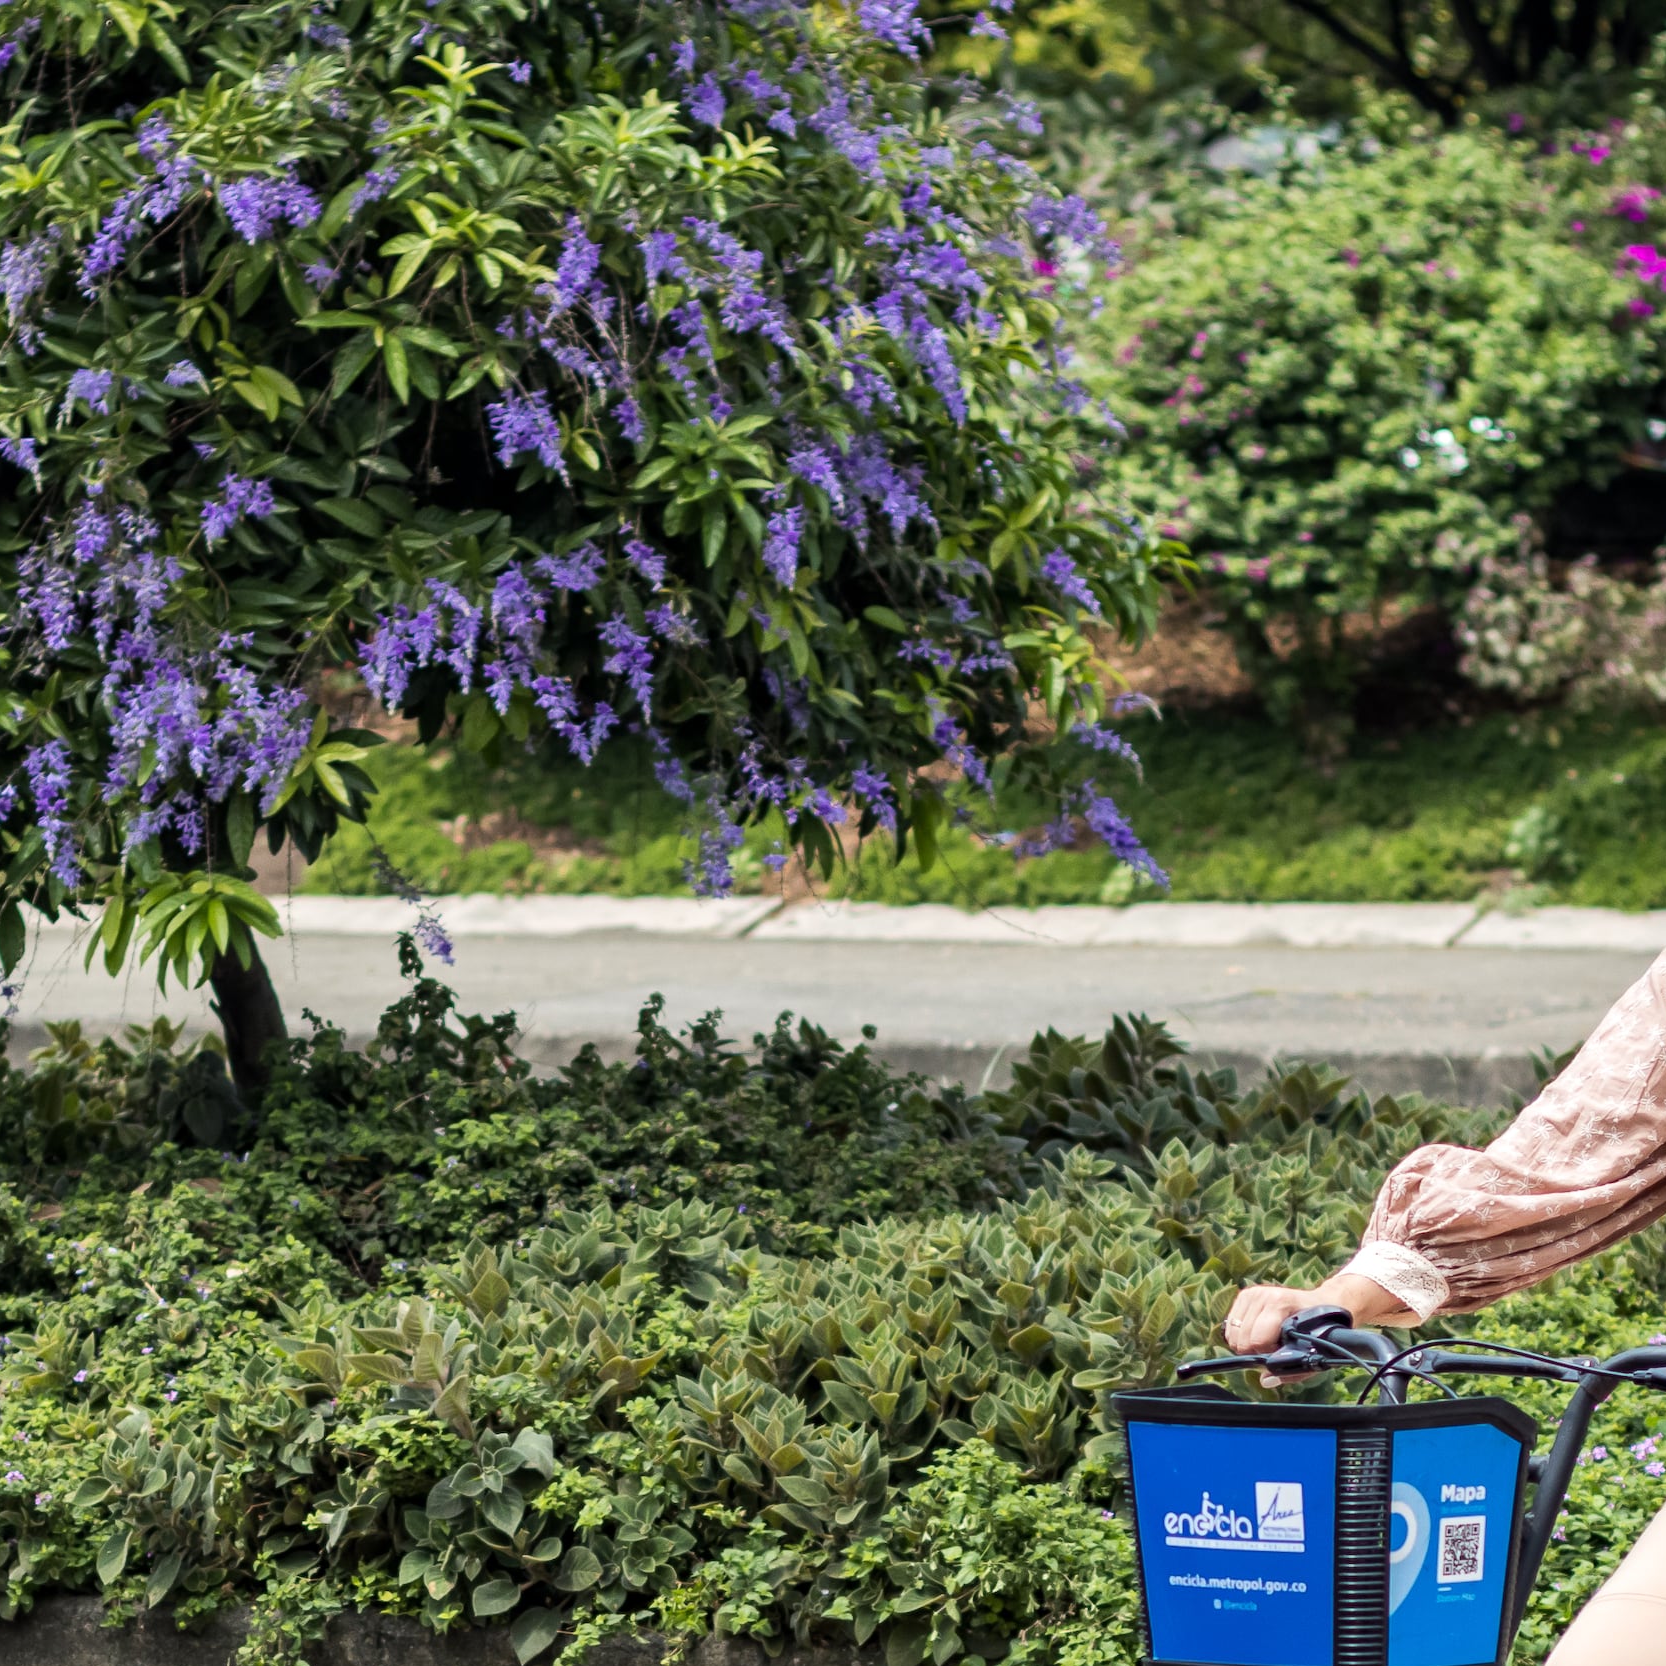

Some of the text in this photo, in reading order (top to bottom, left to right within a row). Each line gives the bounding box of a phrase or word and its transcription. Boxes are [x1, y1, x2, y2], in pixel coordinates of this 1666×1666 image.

[1440, 1484, 1486, 1505] Mapa
[1164, 1497, 1253, 1539] encicla
[1169, 1573, 1307, 1595] encicla.metropol.gov.co
